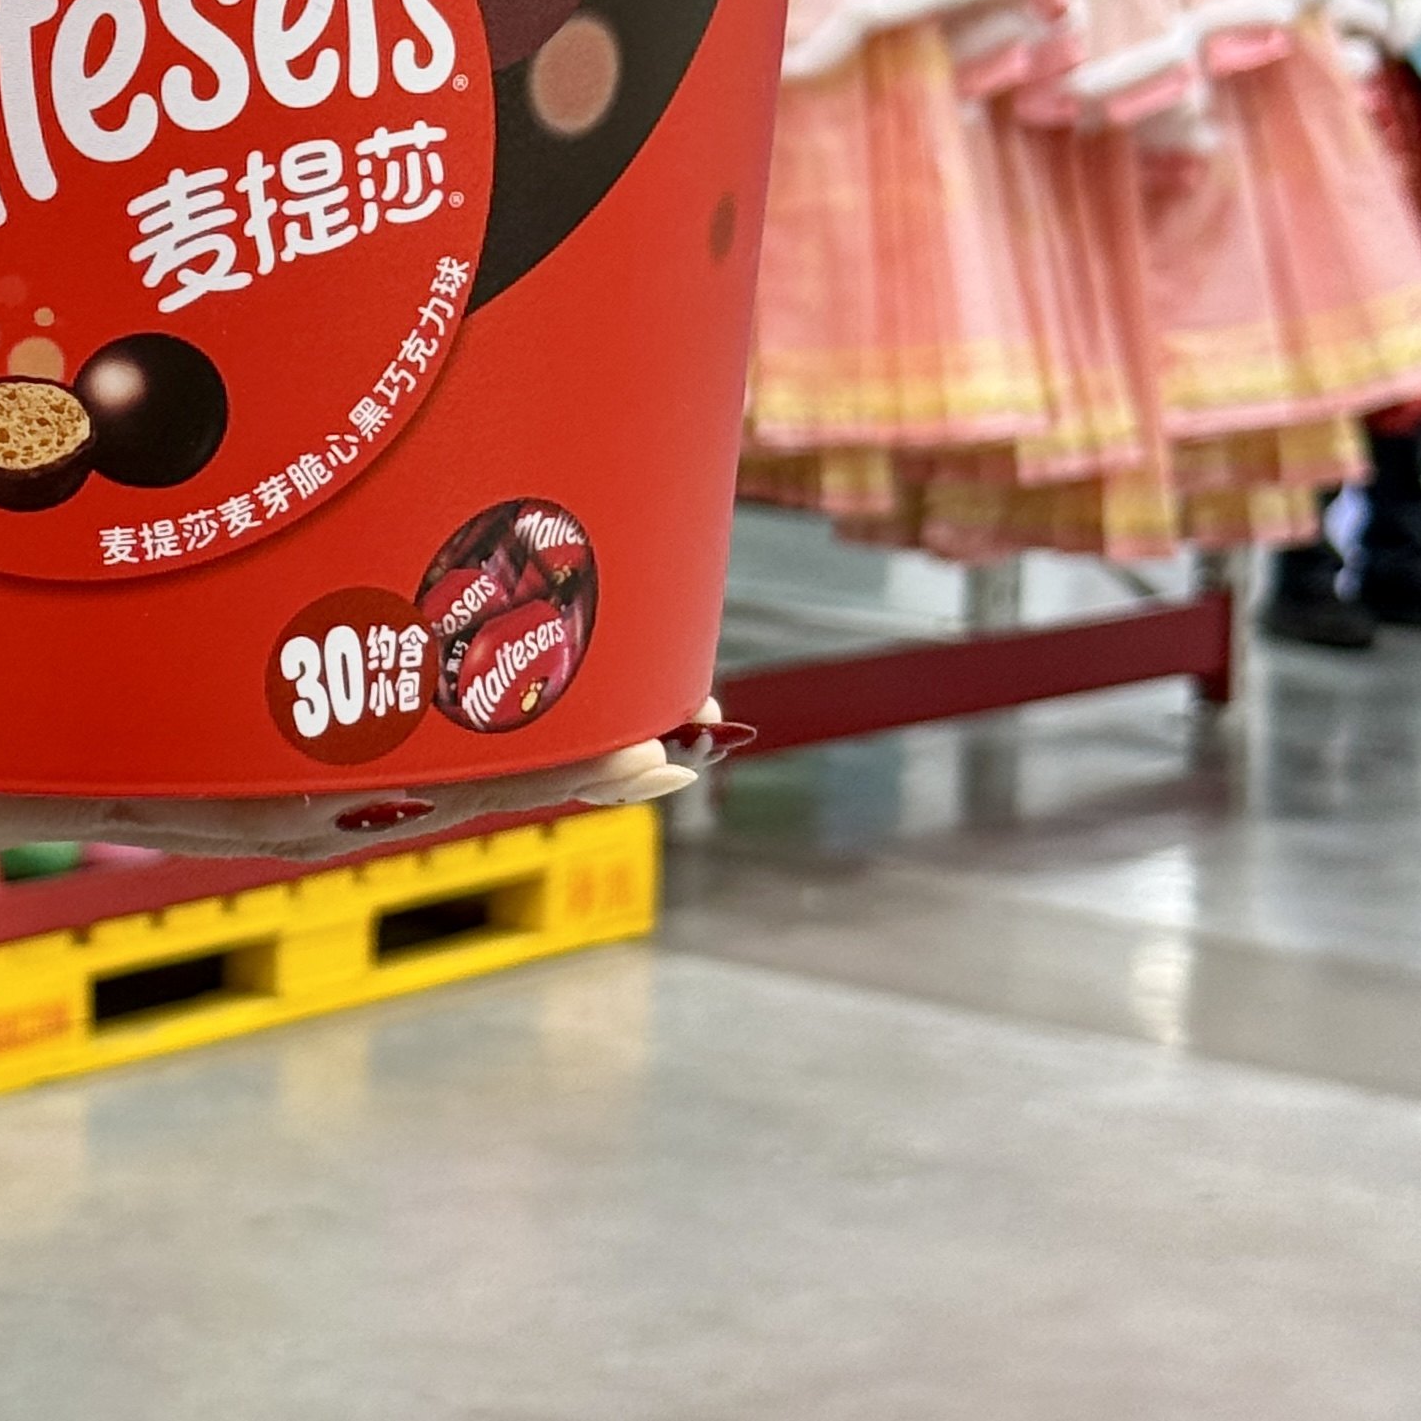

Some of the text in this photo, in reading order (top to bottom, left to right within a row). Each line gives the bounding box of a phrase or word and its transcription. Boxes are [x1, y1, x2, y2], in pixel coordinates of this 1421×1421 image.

[125, 118, 449, 315] 麦提莎
[98, 255, 471, 567] 麦提莎麦芽脆心黑巧克力球
[281, 626, 364, 738] 30
[366, 625, 429, 671] 约含
[368, 672, 421, 718] 小包
[461, 617, 566, 726] Maltesers
